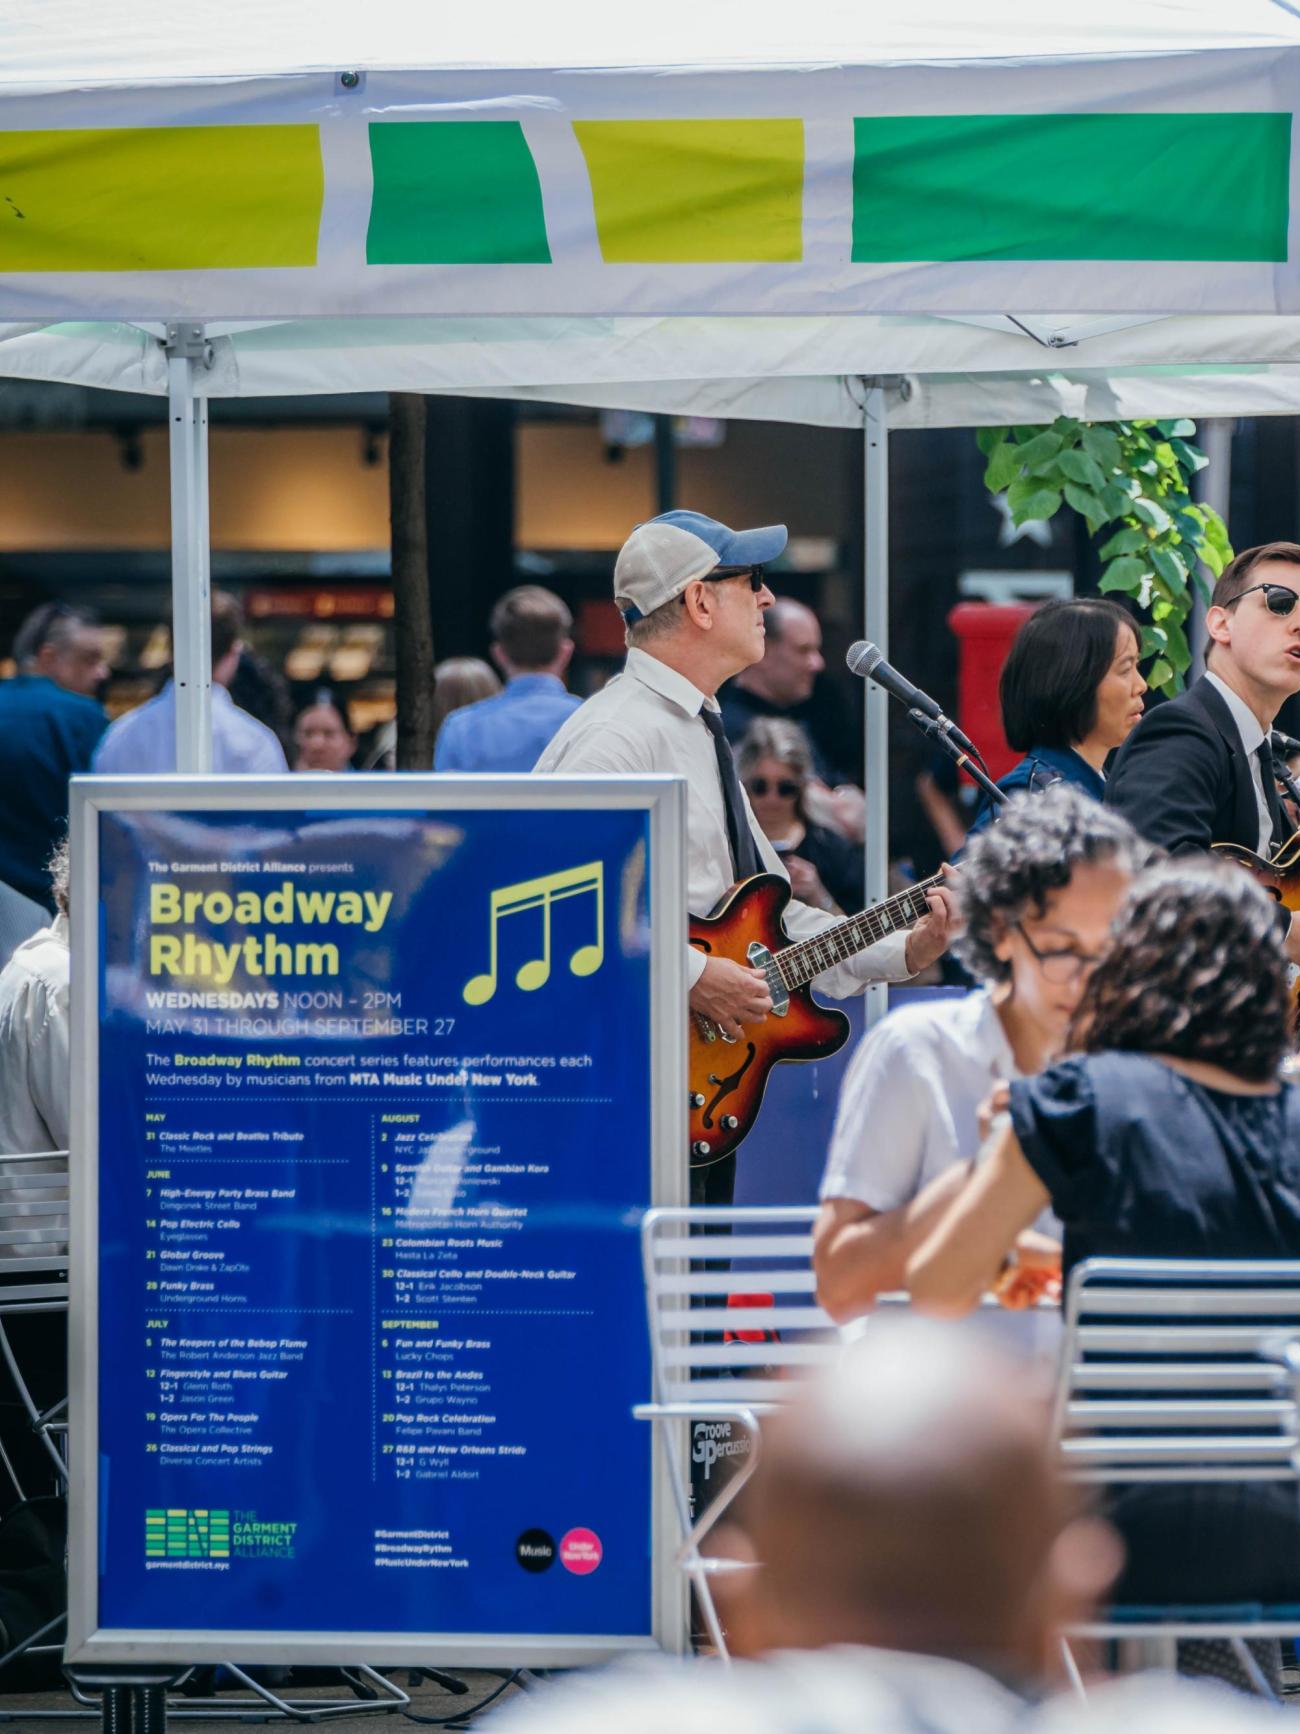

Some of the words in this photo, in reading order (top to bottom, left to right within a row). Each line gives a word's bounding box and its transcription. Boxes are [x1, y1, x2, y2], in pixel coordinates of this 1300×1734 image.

[148, 862, 169, 873] The
[170, 862, 217, 873] Garment
[220, 862, 260, 873] District
[262, 862, 307, 873] Alliance
[309, 863, 355, 874] presents
[150, 883, 393, 932] Broadway
[150, 935, 340, 983] Rhythm
[146, 992, 279, 1009] WEDNESDAYS
[284, 992, 343, 1009] NOON
[362, 992, 402, 1009] 2PM
[146, 1018, 186, 1036] MAY
[193, 1018, 208, 1036] 31
[217, 1018, 308, 1036] THROUGH
[316, 1018, 429, 1036] SEPTEMBER
[434, 1018, 456, 1036] 27
[146, 1054, 170, 1066] The
[174, 1054, 243, 1067] Broadway
[246, 1054, 301, 1067] Rhythm
[304, 1055, 356, 1067] concert
[360, 1056, 399, 1067] series
[403, 1054, 459, 1067] features
[461, 1056, 556, 1068] performances
[559, 1055, 593, 1068] each
[146, 1073, 222, 1087] Wednesday
[225, 1073, 242, 1087] by
[246, 1075, 311, 1086] musicians
[314, 1073, 346, 1086] from
[349, 1073, 380, 1086] MTA
[383, 1073, 423, 1086] Music
[472, 1073, 503, 1086] New
[145, 1114, 166, 1122] MAY
[381, 1115, 421, 1123] AUGUST
[146, 1132, 155, 1141] 31
[158, 1132, 190, 1141] Classic
[192, 1132, 215, 1141] Rock
[217, 1132, 235, 1141] and
[236, 1132, 270, 1141] Beatles
[272, 1132, 305, 1141] Tribute
[146, 1171, 171, 1179] JUNE
[145, 1189, 152, 1197] 7
[218, 1189, 243, 1199] Party
[244, 1189, 269, 1198] Brass
[271, 1189, 296, 1198] Band
[205, 1202, 231, 1210] Street
[234, 1202, 258, 1210] Band
[381, 1207, 392, 1217] 16
[491, 1207, 528, 1217] Quartet
[145, 1220, 156, 1228] 14
[159, 1220, 179, 1229] Pop
[180, 1220, 215, 1229] Electric
[217, 1220, 241, 1229] Cello
[395, 1239, 446, 1248] Colombian
[447, 1239, 475, 1248] Roots
[477, 1239, 504, 1248] Music
[145, 1251, 156, 1259] 21
[159, 1251, 191, 1260] Global
[192, 1251, 225, 1260] Groove
[396, 1269, 437, 1279] Classical
[438, 1269, 463, 1279] Cello
[464, 1270, 483, 1279] and
[547, 1270, 577, 1279] Guitar
[159, 1282, 188, 1291] Funky
[190, 1282, 215, 1291] Brass
[159, 1294, 220, 1303] Underground
[145, 1320, 169, 1329] JULY
[381, 1320, 440, 1329] SEPTEMBER
[160, 1339, 177, 1347] The
[178, 1339, 216, 1348] Keepers
[218, 1339, 229, 1348] of
[230, 1339, 245, 1348] the
[247, 1339, 278, 1349] Bebop
[381, 1339, 388, 1348] 6
[395, 1339, 414, 1348] Fun
[414, 1339, 434, 1348] and
[435, 1339, 464, 1349] Funky
[465, 1339, 491, 1349] Brass
[395, 1352, 423, 1361] Lucky
[424, 1352, 454, 1361] Chops
[145, 1370, 155, 1378] 12
[159, 1370, 211, 1380] Fingerstyle
[213, 1370, 231, 1379] and
[232, 1370, 258, 1379] Blues
[259, 1370, 289, 1380] Guitar
[395, 1370, 423, 1380] Brazil
[424, 1370, 435, 1380] to
[436, 1370, 453, 1380] the
[454, 1370, 484, 1380] Andes
[145, 1413, 156, 1421] 19
[159, 1413, 188, 1422] Opera
[190, 1413, 206, 1422] For
[209, 1413, 225, 1422] The
[227, 1413, 260, 1423] People
[382, 1414, 395, 1422] 20
[395, 1414, 414, 1424] Pop
[416, 1414, 440, 1423] Rock
[442, 1414, 497, 1424] Celebration
[178, 1426, 207, 1434] Opera
[692, 1423, 732, 1463] Groove
[159, 1444, 200, 1453] Classical
[201, 1444, 220, 1453] and
[221, 1444, 239, 1454] Pop
[241, 1444, 273, 1454] Strings
[382, 1445, 394, 1454] 27
[417, 1445, 436, 1454] and
[437, 1445, 458, 1454] New
[460, 1445, 496, 1455] Orleans
[704, 1435, 753, 1480] Percussio
[233, 1510, 259, 1521] THE
[232, 1523, 298, 1534] GARMENT
[232, 1535, 292, 1545] DISTRICT
[233, 1547, 296, 1558] ALLIANCE
[519, 1544, 552, 1557] Music
